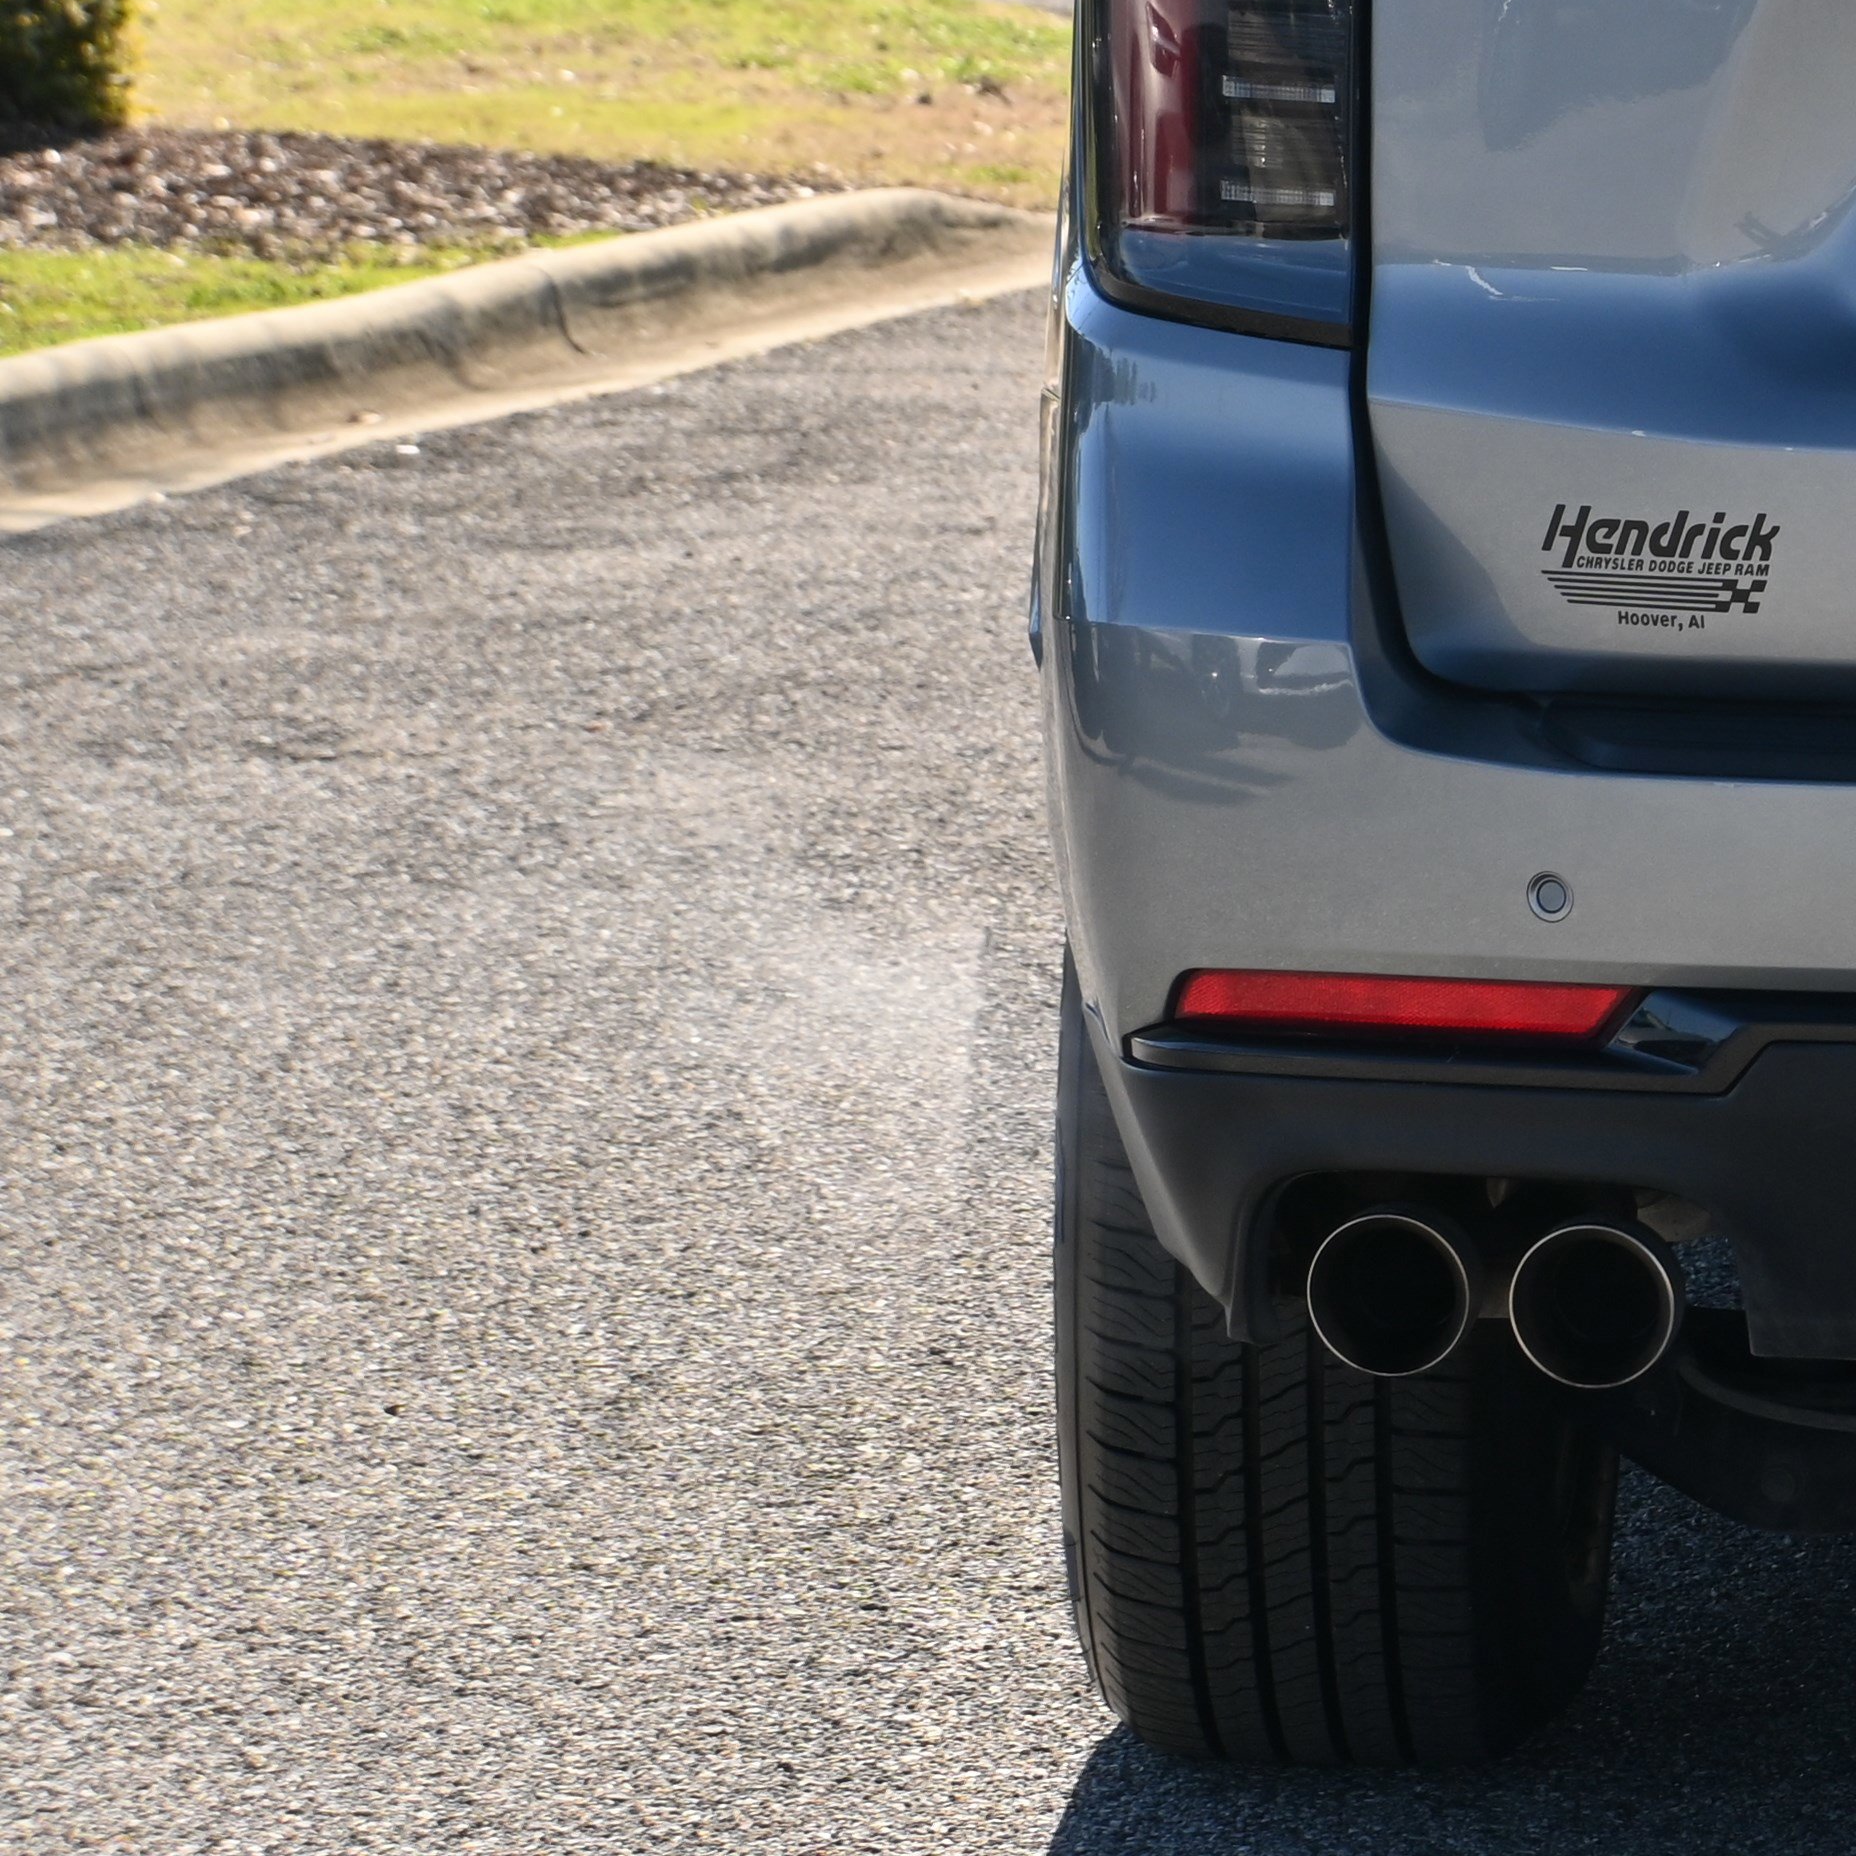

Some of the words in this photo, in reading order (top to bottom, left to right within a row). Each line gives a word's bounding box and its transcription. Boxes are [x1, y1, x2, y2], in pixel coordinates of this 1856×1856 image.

[1541, 504, 1781, 569] Hendrick
[1576, 555, 1644, 571] CHRYSLER
[1648, 559, 1694, 574] DODGE
[1698, 562, 1731, 575] JEEP
[1734, 564, 1770, 576] RAM
[1617, 610, 1684, 632] Hoover,
